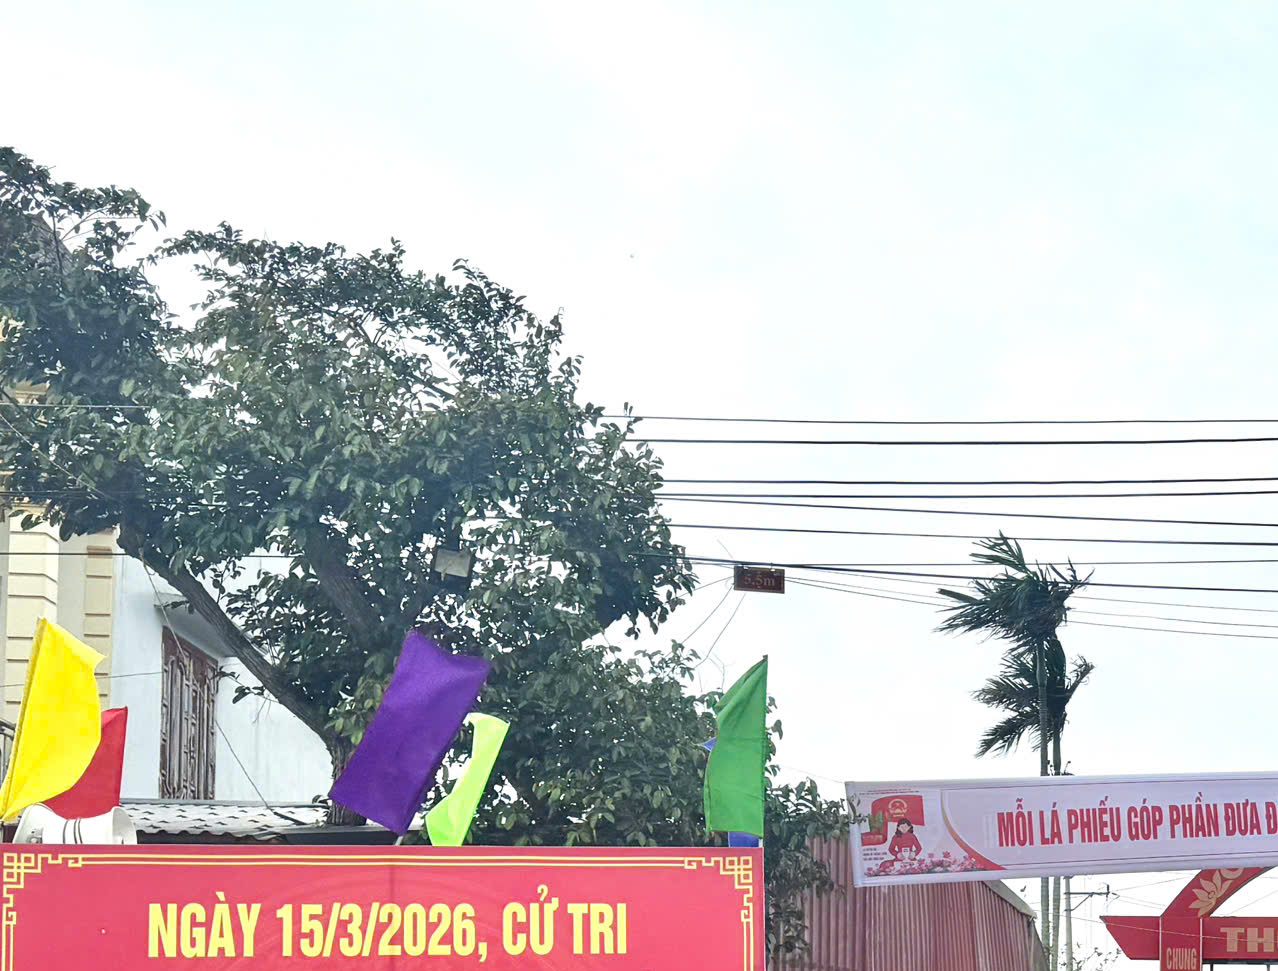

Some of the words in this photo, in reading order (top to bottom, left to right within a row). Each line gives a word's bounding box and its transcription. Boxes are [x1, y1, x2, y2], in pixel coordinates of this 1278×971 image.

[998, 798, 1034, 847] MỖI
[1040, 802, 1062, 845] LÁ
[1068, 796, 1121, 843] PHIẾU
[1128, 798, 1163, 840] GÓP
[1169, 792, 1219, 838] PHẦN
[1224, 799, 1262, 836] ĐƯA
[148, 892, 261, 958] NGÀY
[276, 902, 487, 962] 15/3/2026,
[503, 884, 559, 955] CỬ
[567, 903, 627, 954] TRI
[1166, 948, 1197, 970] CHUNG
